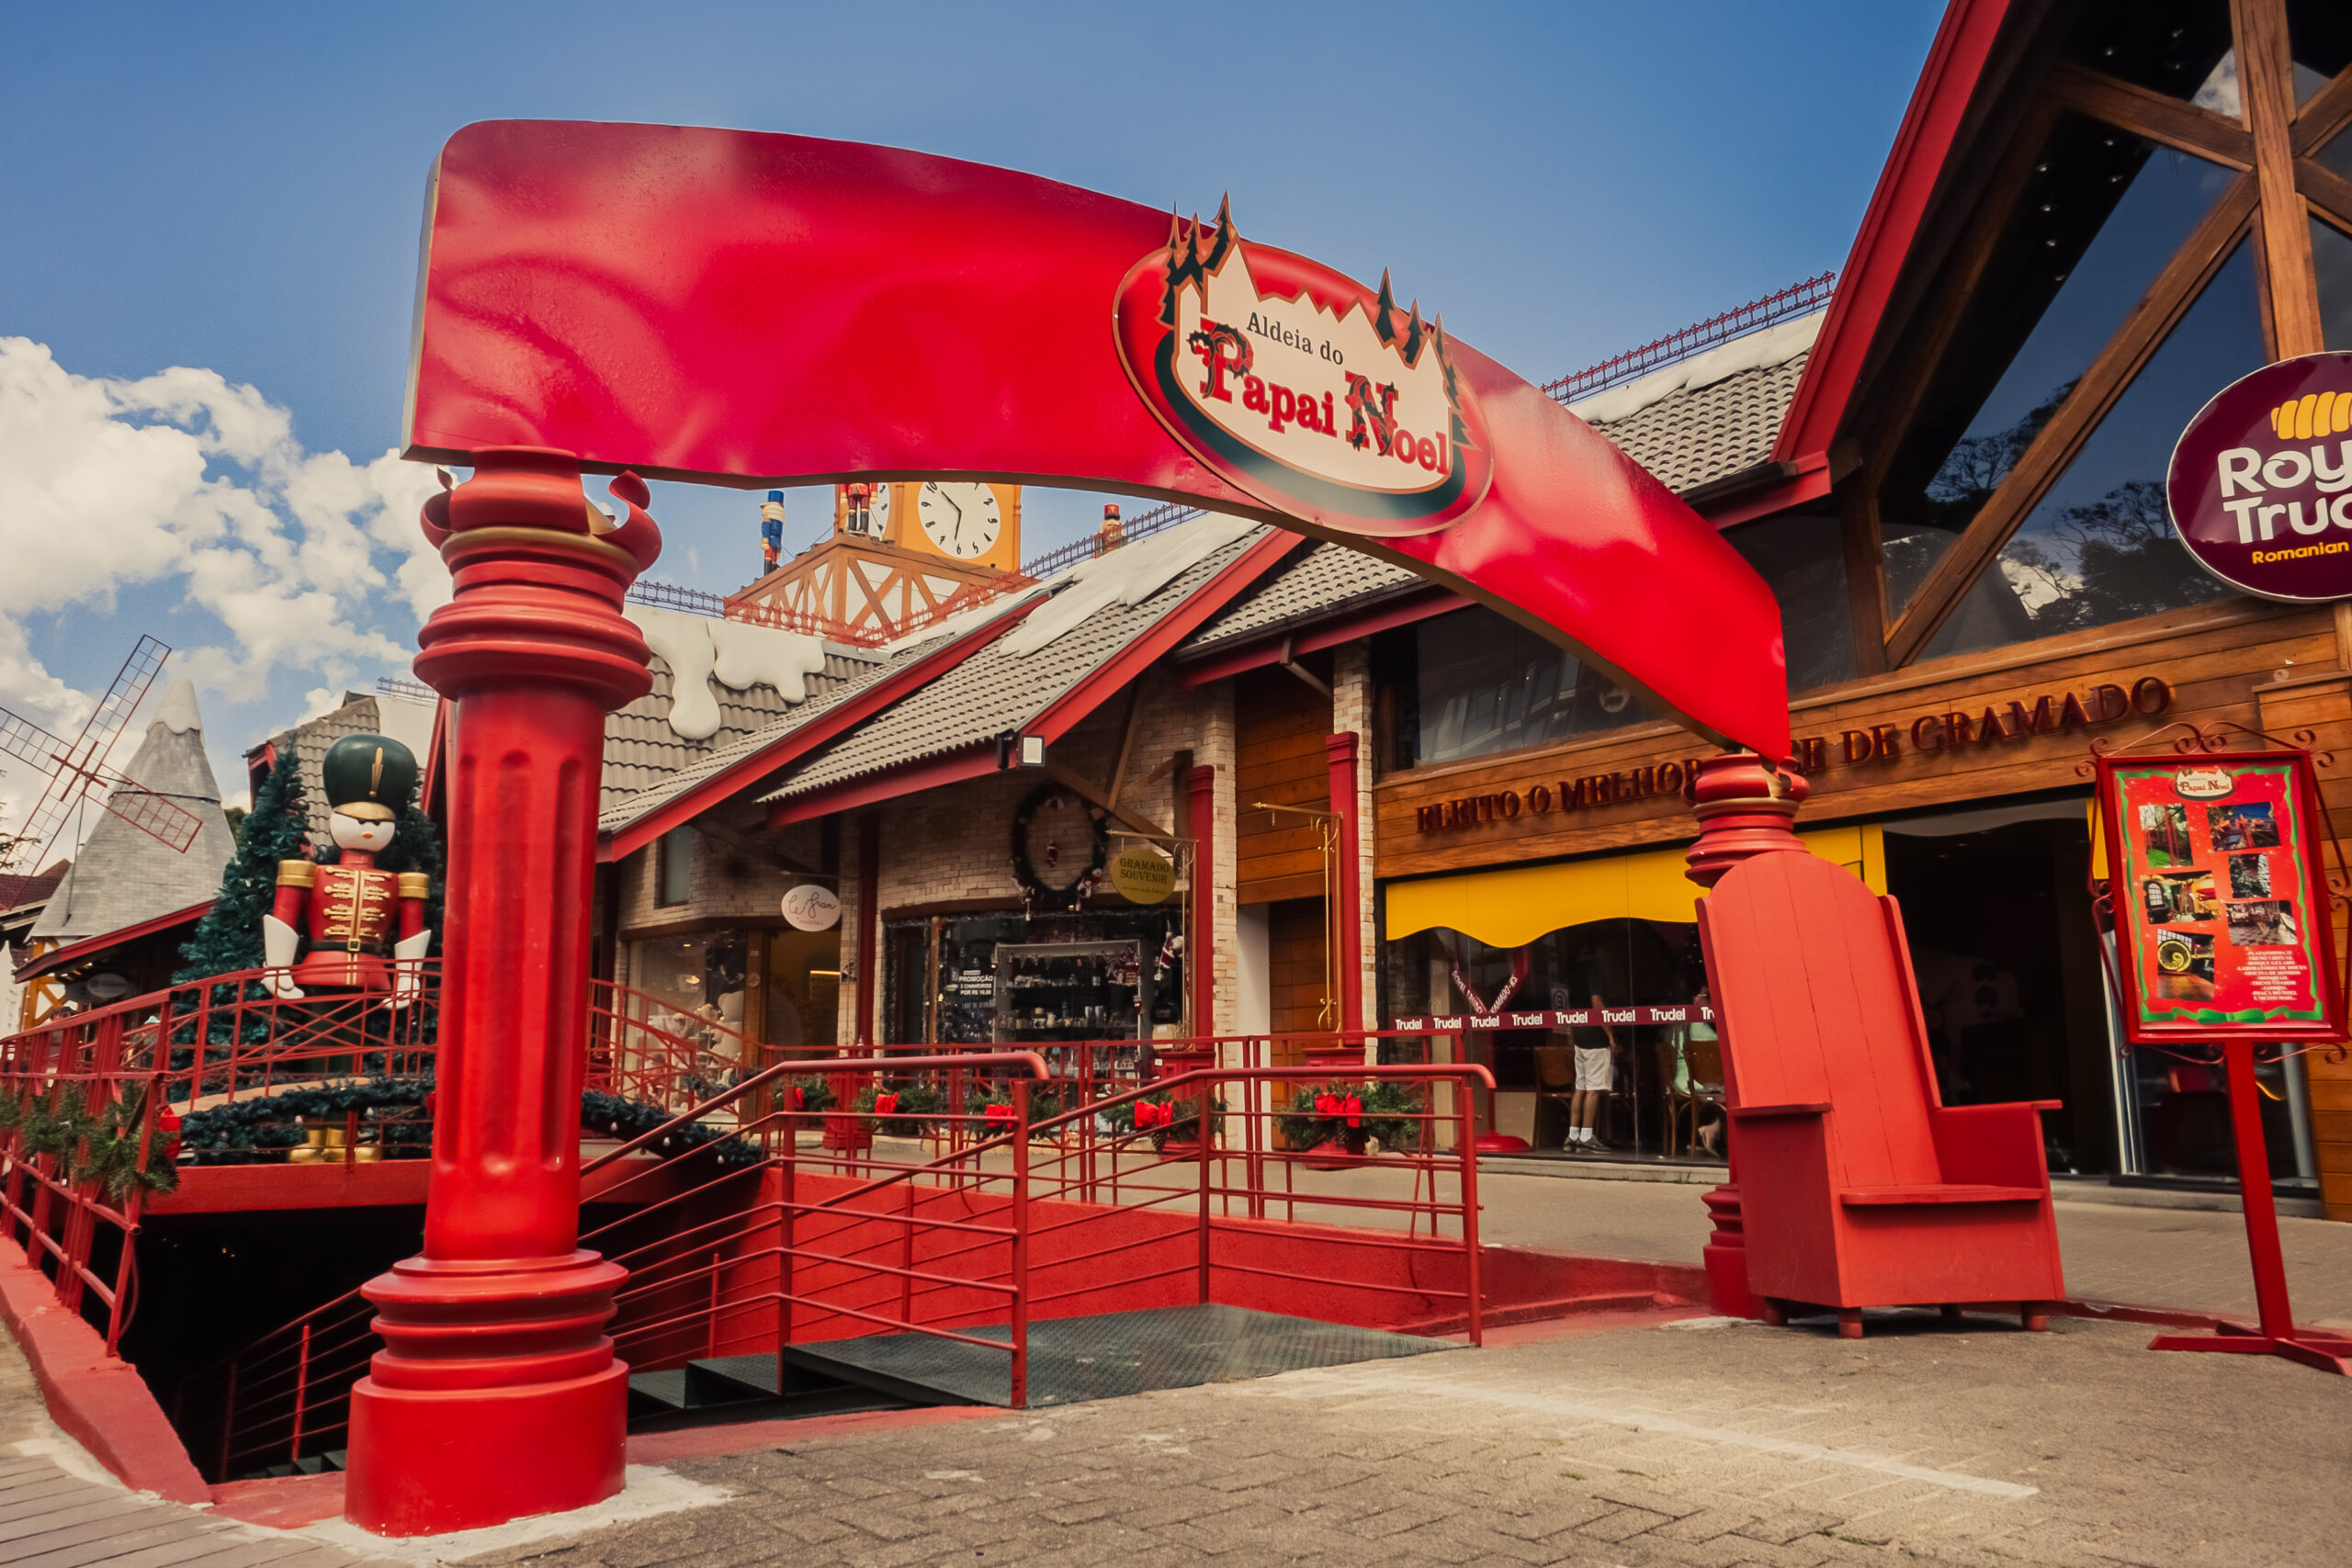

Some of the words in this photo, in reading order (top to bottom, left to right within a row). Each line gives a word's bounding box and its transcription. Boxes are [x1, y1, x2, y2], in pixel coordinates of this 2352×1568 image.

[1247, 311, 1314, 355] Aldeia
[1320, 340, 1344, 366] do
[1186, 318, 1338, 438] Papai
[1344, 369, 1450, 477] Noel
[956, 543, 962, 555] 6
[2252, 541, 2349, 564] Romanian
[1416, 789, 1520, 833] ELEITO
[1528, 784, 1552, 814] O
[1840, 722, 1900, 763] DE
[1911, 676, 2171, 751] GRAMADO
[1120, 857, 1170, 873] GRAMADO
[1120, 869, 1168, 885] SOUVENIR
[1511, 1013, 1544, 1026] Trudel
[1555, 1011, 1588, 1024] Trudel
[1601, 1010, 1635, 1022] Trudel
[1650, 1008, 1686, 1021] Trudel
[1395, 1018, 1422, 1031] Trudel
[1433, 1017, 1462, 1029] Trudel
[1470, 1016, 1499, 1028] Trudel
